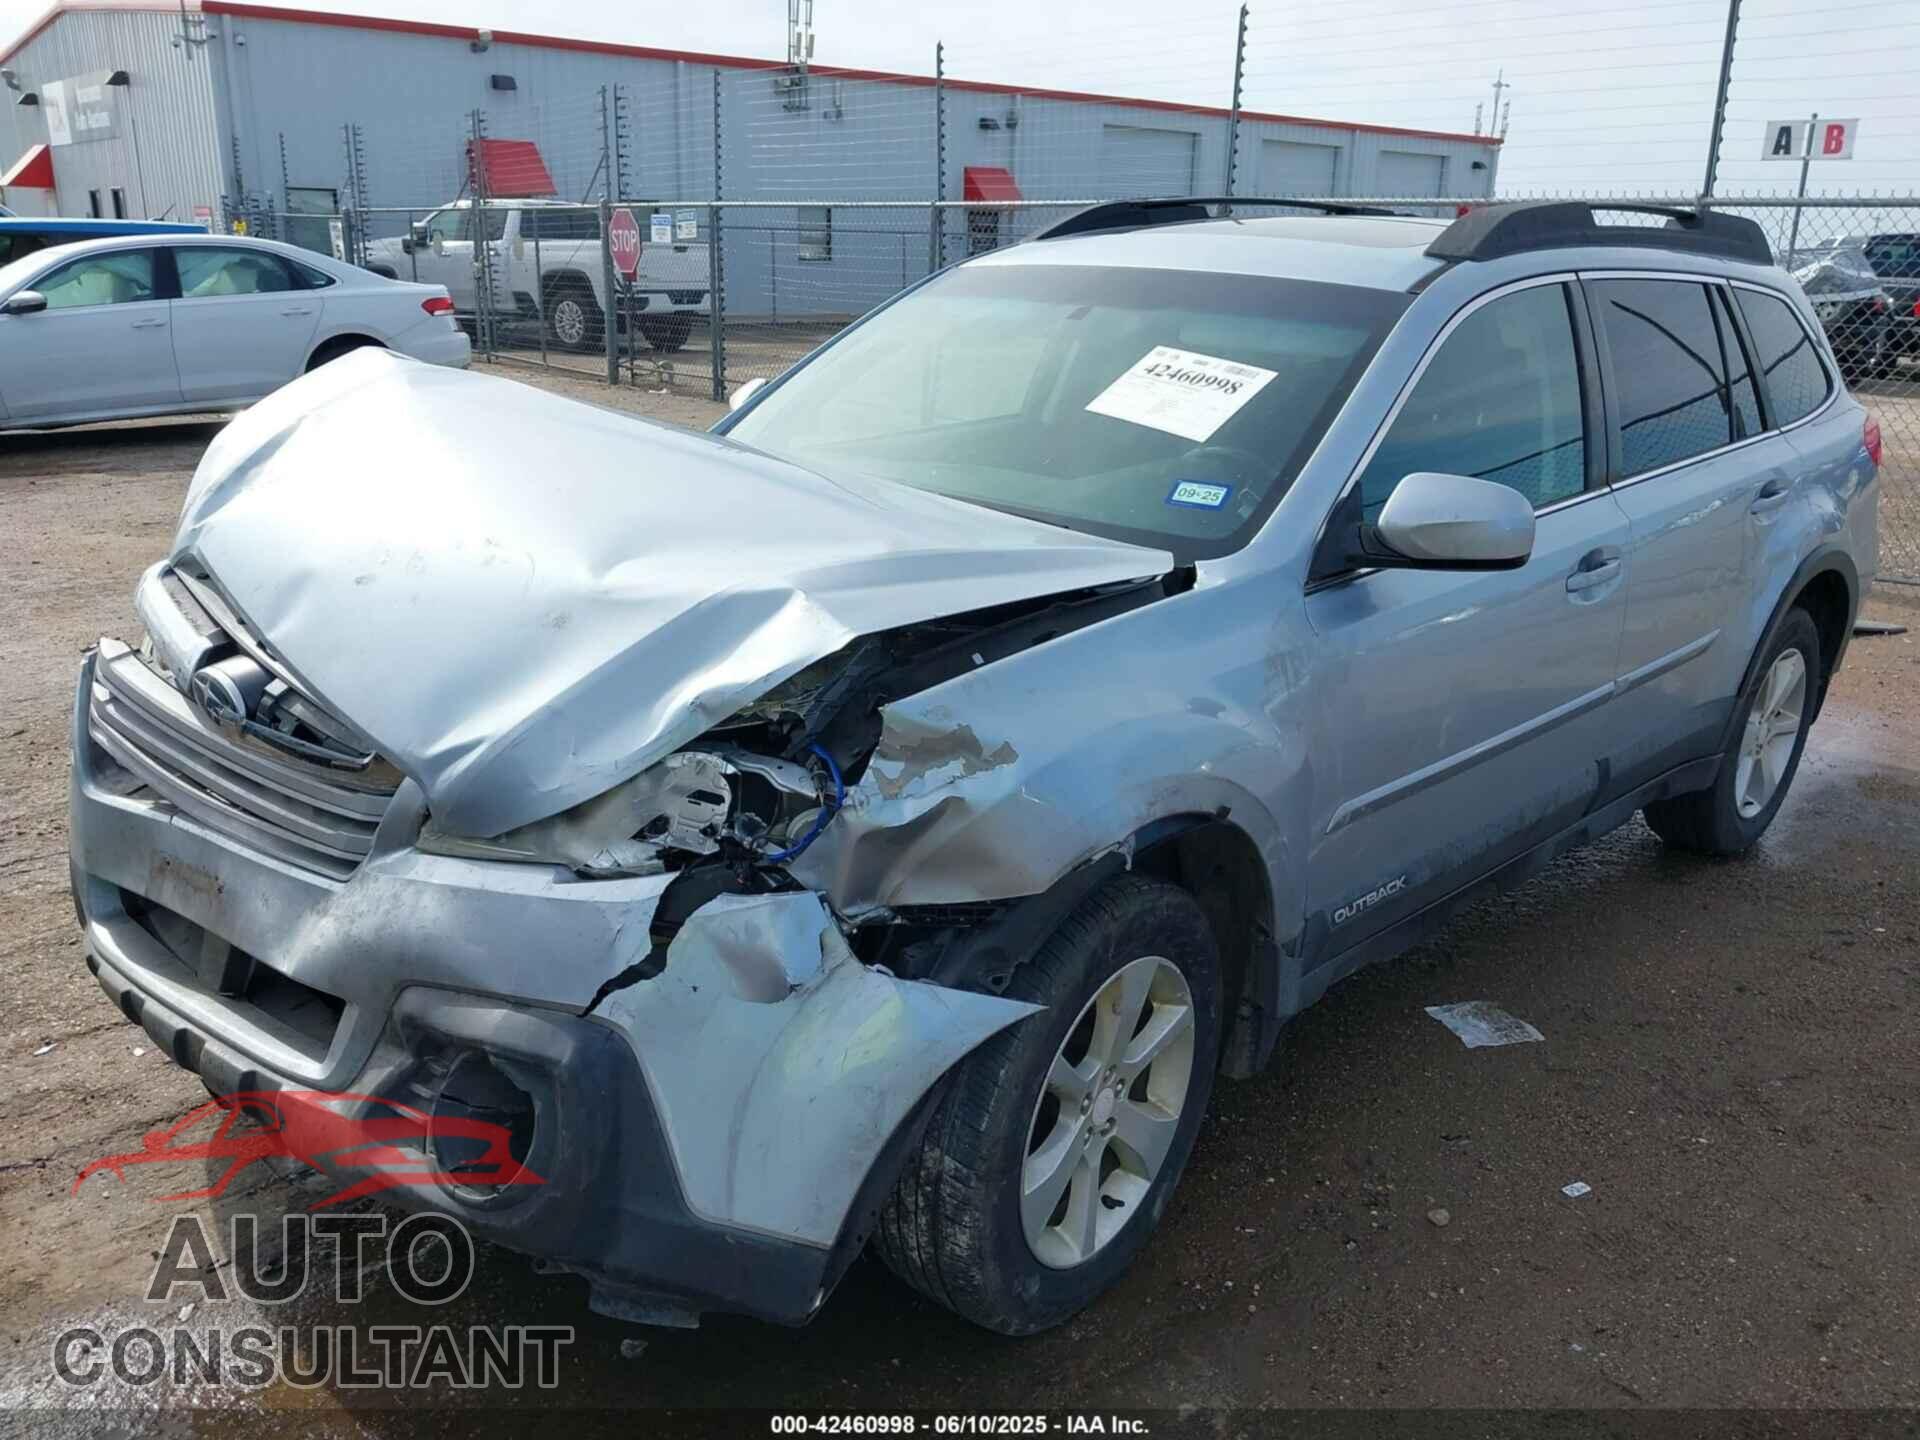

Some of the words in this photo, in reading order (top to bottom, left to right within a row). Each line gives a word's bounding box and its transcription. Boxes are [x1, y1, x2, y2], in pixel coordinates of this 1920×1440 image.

[1771, 126, 1792, 155] A
[1822, 124, 1845, 154] B
[611, 229, 637, 253] STOP
[1143, 362, 1244, 395] 42460998
[1334, 875, 1406, 923] OUTBACK
